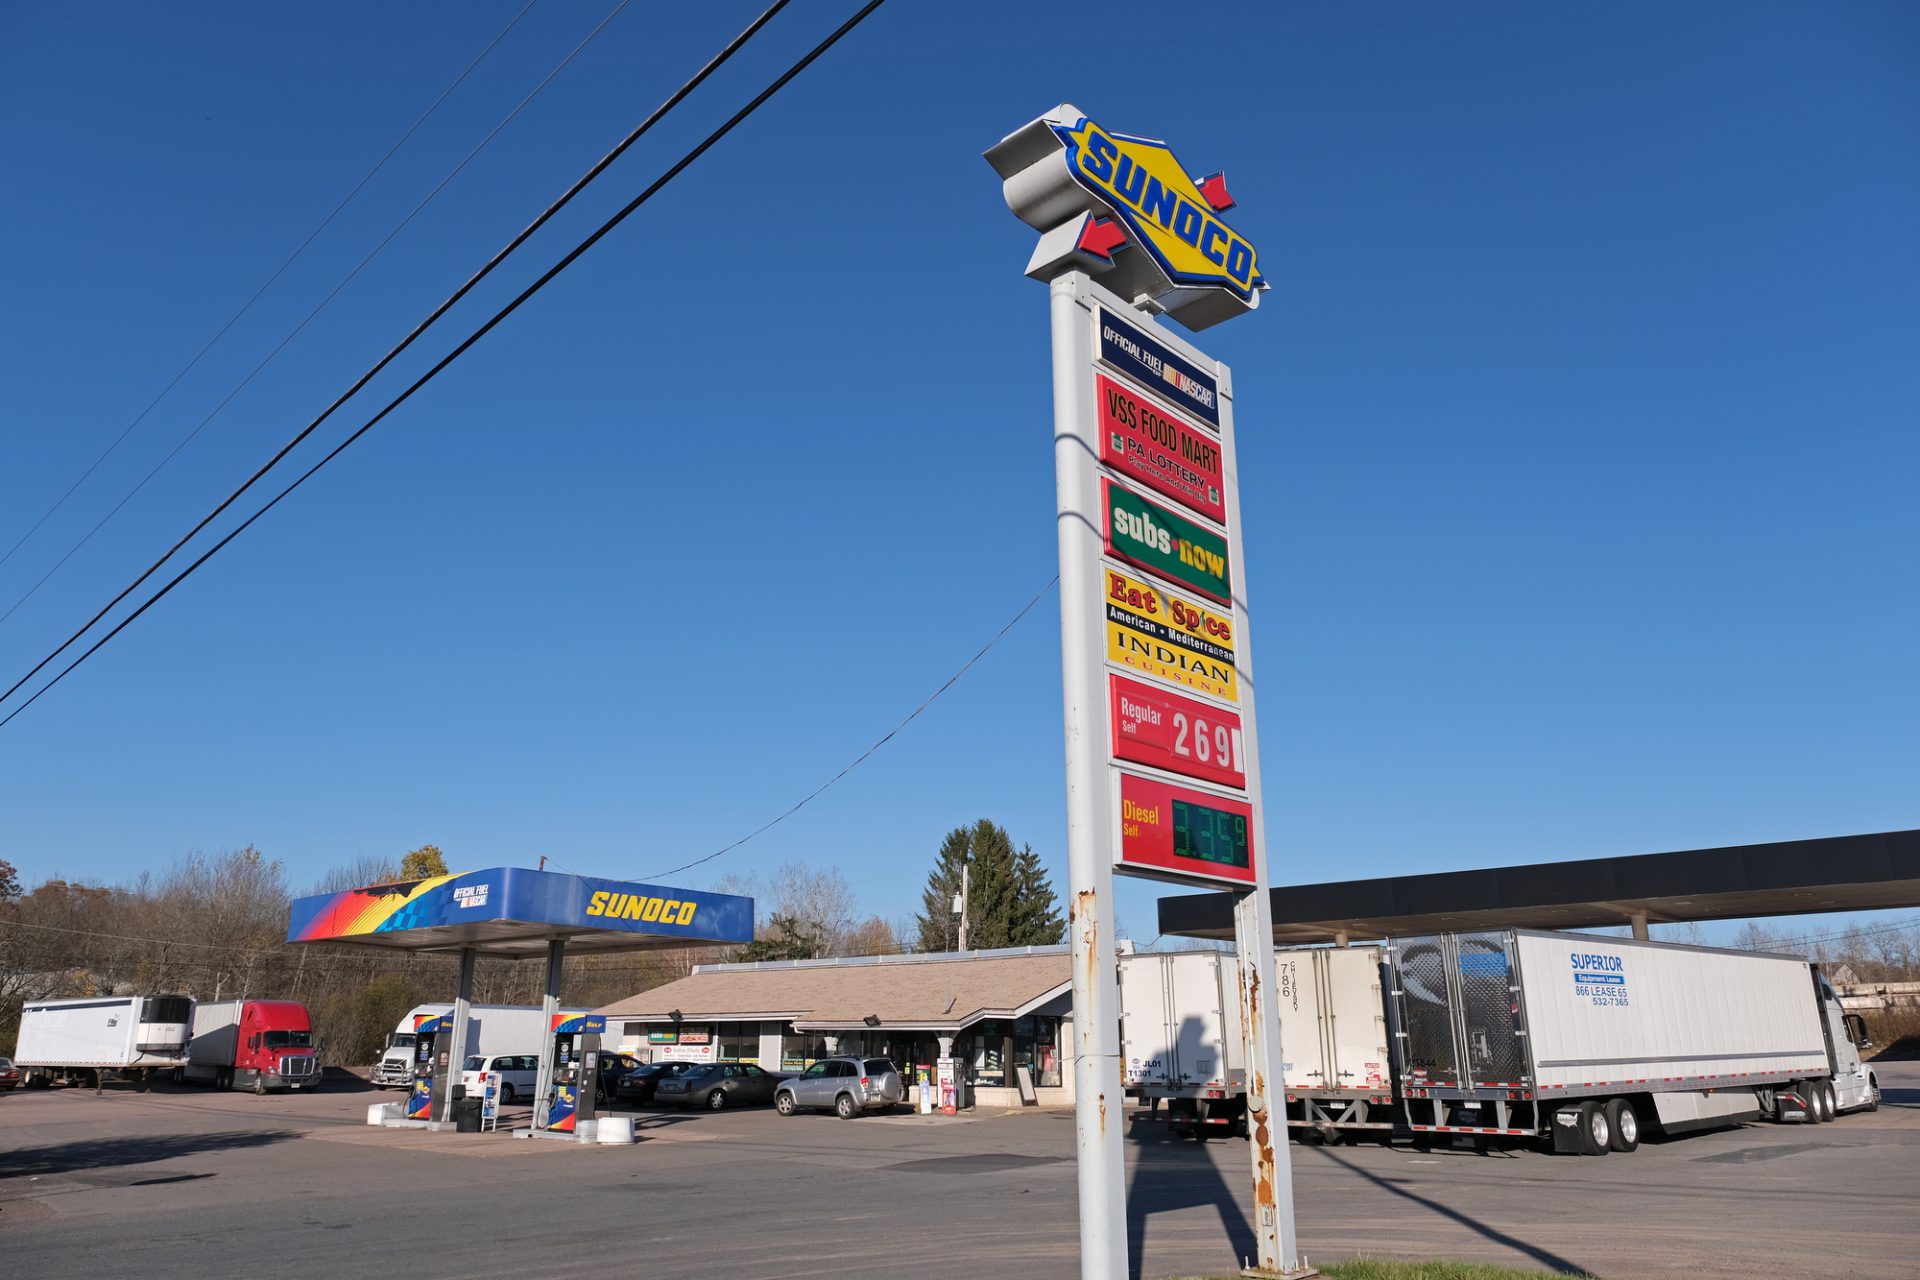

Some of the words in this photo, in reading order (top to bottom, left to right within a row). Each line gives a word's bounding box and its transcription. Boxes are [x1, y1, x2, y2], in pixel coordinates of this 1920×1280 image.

[1082, 130, 1253, 286] SUNOCO
[1103, 325, 1142, 361] OFFICIAL
[1143, 351, 1163, 372] FUEL
[1178, 371, 1214, 408] NASCAR
[1107, 388, 1137, 430] VSS
[1141, 407, 1177, 452] FOOD
[1181, 431, 1217, 475] MART
[1127, 437, 1146, 458] PA
[1149, 449, 1206, 489] LOTTERY
[1128, 455, 1144, 470] Play
[1165, 475, 1179, 488] And
[1114, 507, 1171, 555] subs
[1178, 538, 1225, 580] now
[1109, 573, 1157, 614] Eat
[1172, 600, 1231, 641] Spice
[1110, 606, 1156, 633] American
[1168, 628, 1234, 662] Mediterranean
[1117, 631, 1230, 684] INDIAN
[1124, 656, 1226, 696] CUISINE
[1121, 696, 1162, 726] Regular
[1122, 722, 1137, 735] Self
[1123, 799, 1160, 825] Diesel
[1123, 823, 1138, 838] Self
[586, 890, 697, 926] SUNOCO
[1570, 953, 1624, 972] SUPERIOR
[1575, 985, 1590, 996] 866
[1591, 986, 1617, 997] LEASE
[1618, 988, 1628, 998] 65
[1143, 1060, 1162, 1068] JL01
